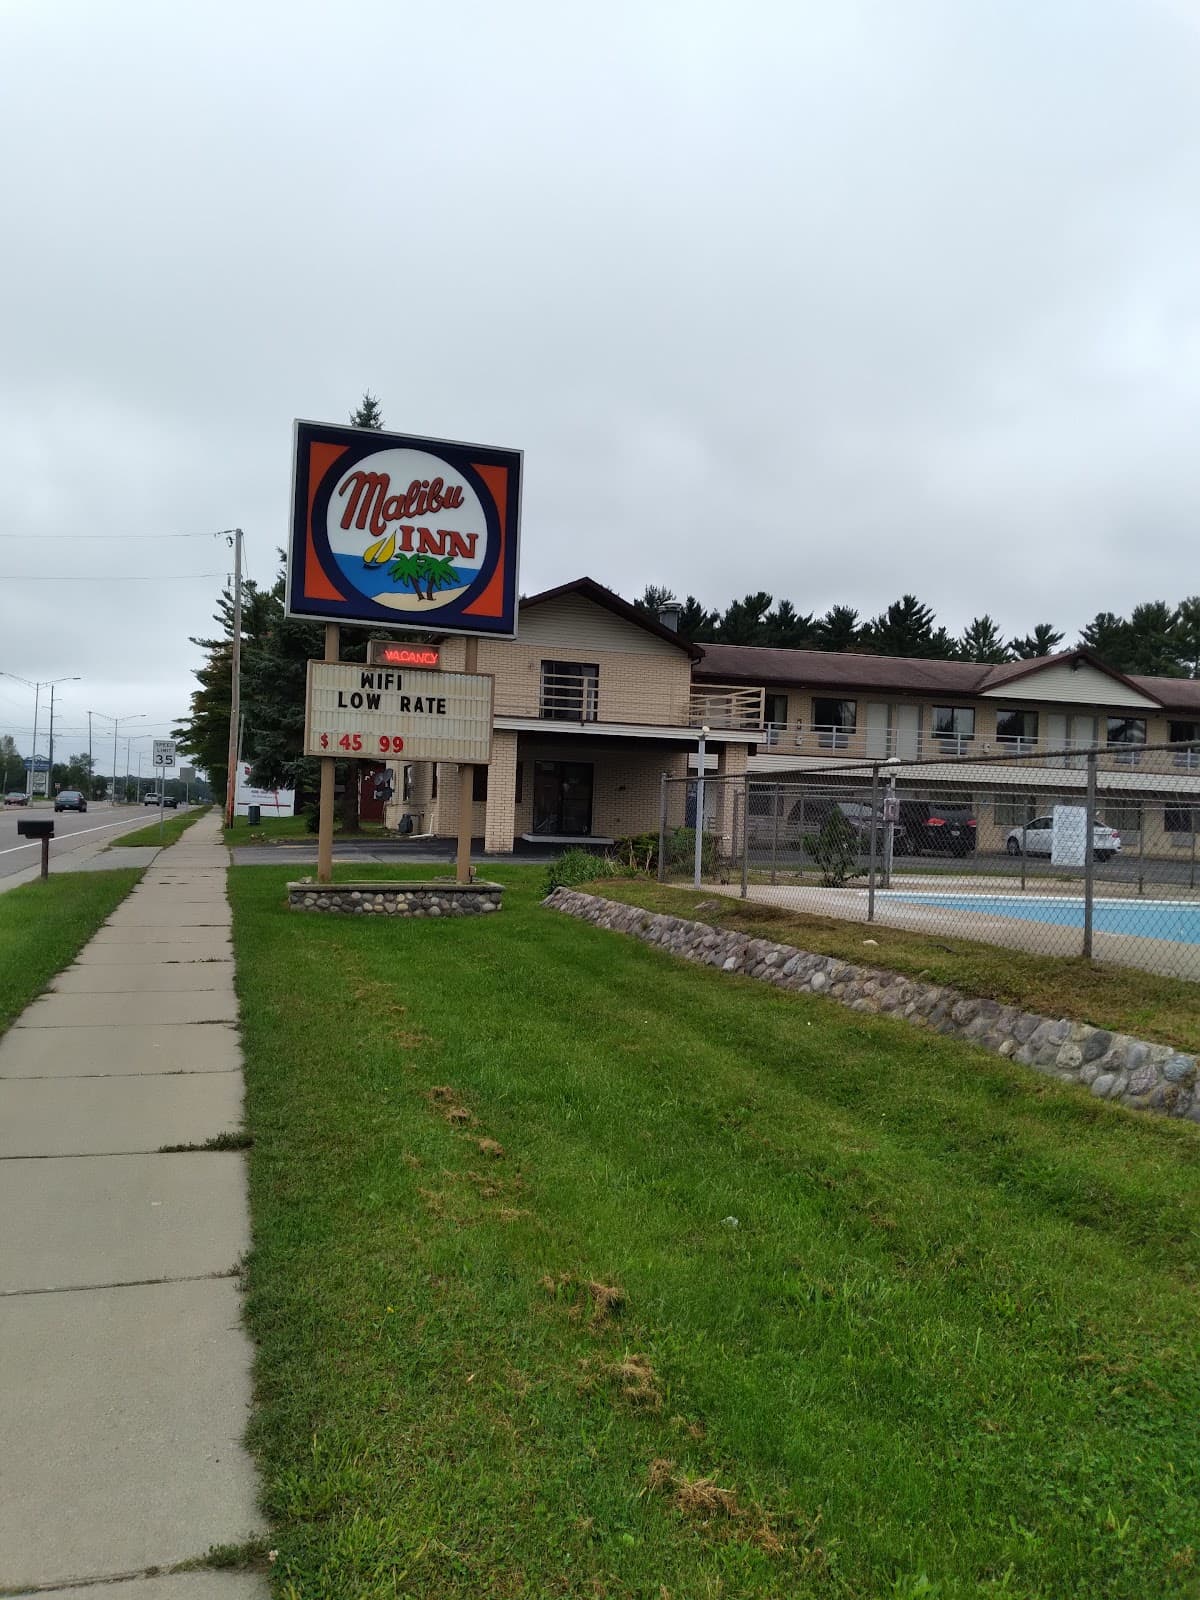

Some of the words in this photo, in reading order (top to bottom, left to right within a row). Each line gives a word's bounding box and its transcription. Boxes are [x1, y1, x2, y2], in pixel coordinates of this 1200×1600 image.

[339, 471, 464, 536] Malibu
[399, 525, 479, 559] INN
[384, 649, 438, 665] VACANCY
[361, 672, 402, 690] WIFI
[338, 691, 381, 710] LOW
[400, 696, 446, 714] RATE
[320, 733, 329, 749] $
[339, 734, 362, 751] 45
[379, 736, 404, 753] 99
[155, 754, 173, 765] 35
